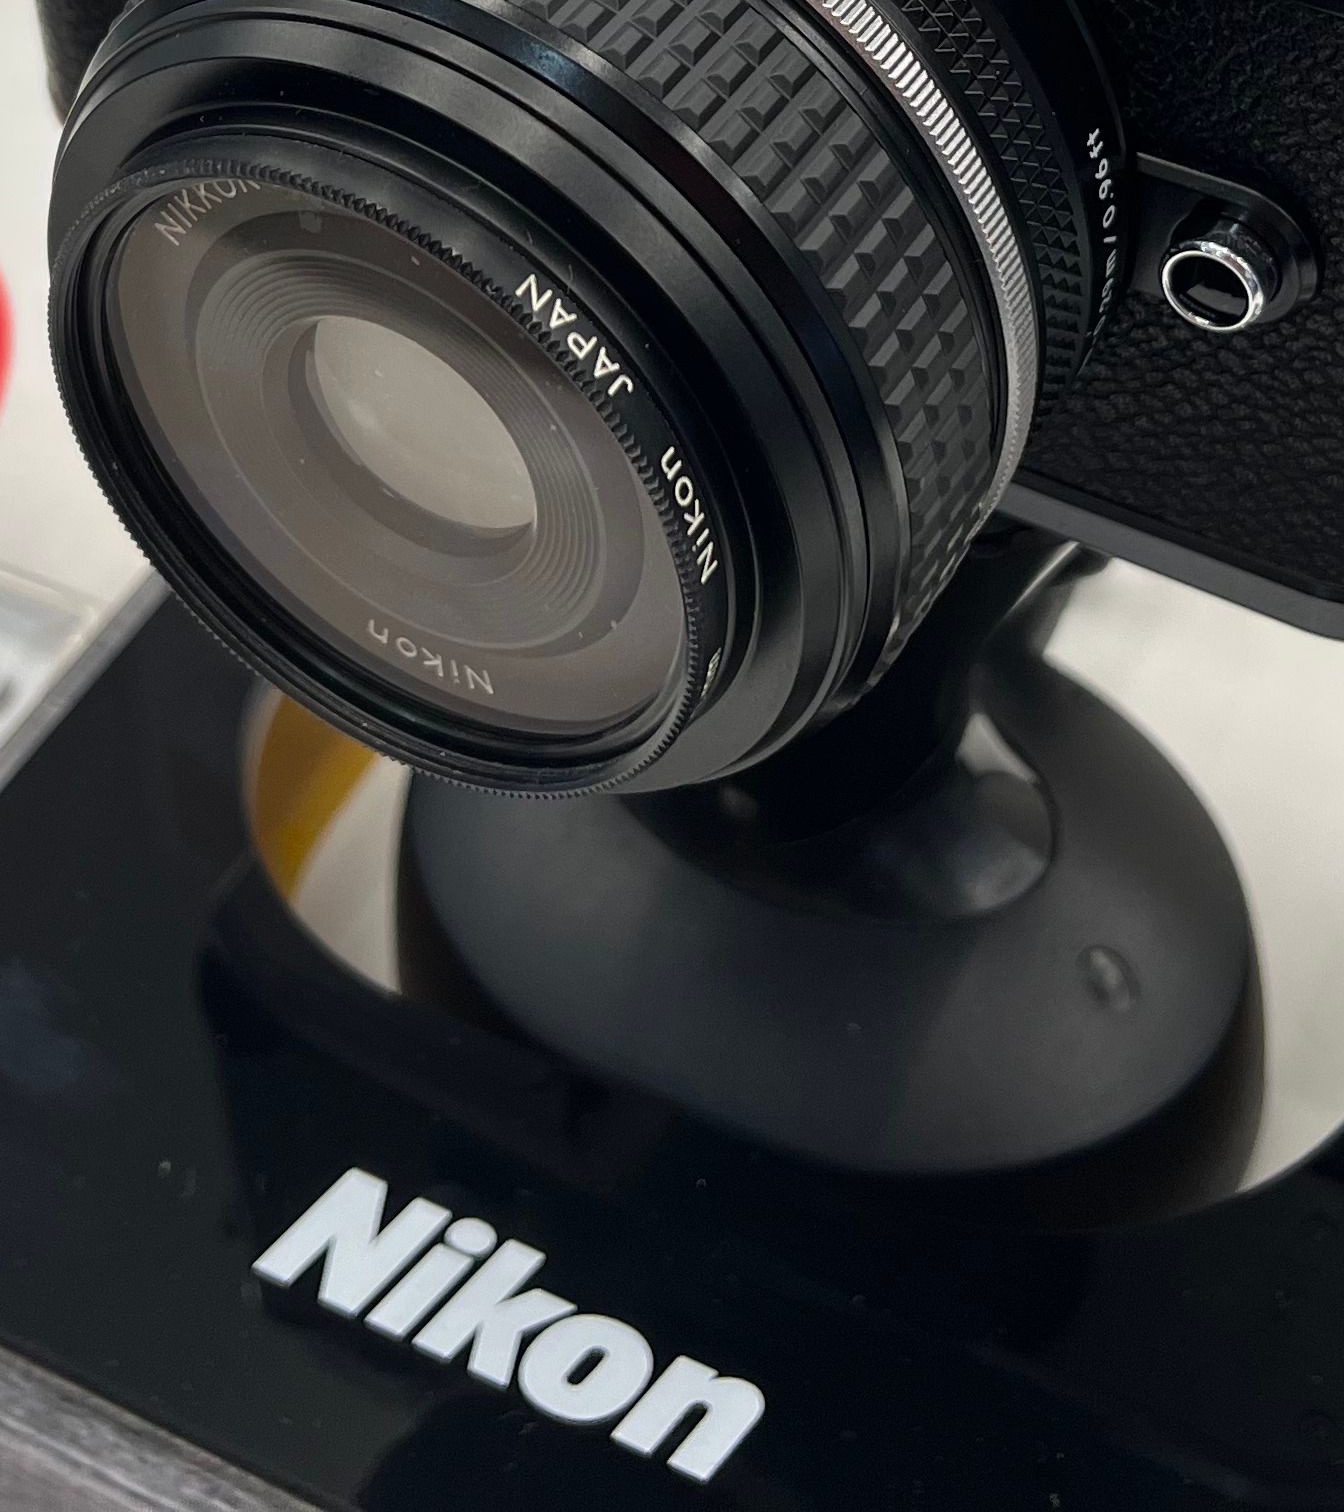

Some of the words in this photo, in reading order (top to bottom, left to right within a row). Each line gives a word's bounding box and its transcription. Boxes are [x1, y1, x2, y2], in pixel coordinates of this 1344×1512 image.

[514, 273, 634, 395] JAPAN
[659, 446, 719, 584] Nikon
[366, 617, 495, 696] Nikon
[251, 1167, 766, 1483] Nikon
